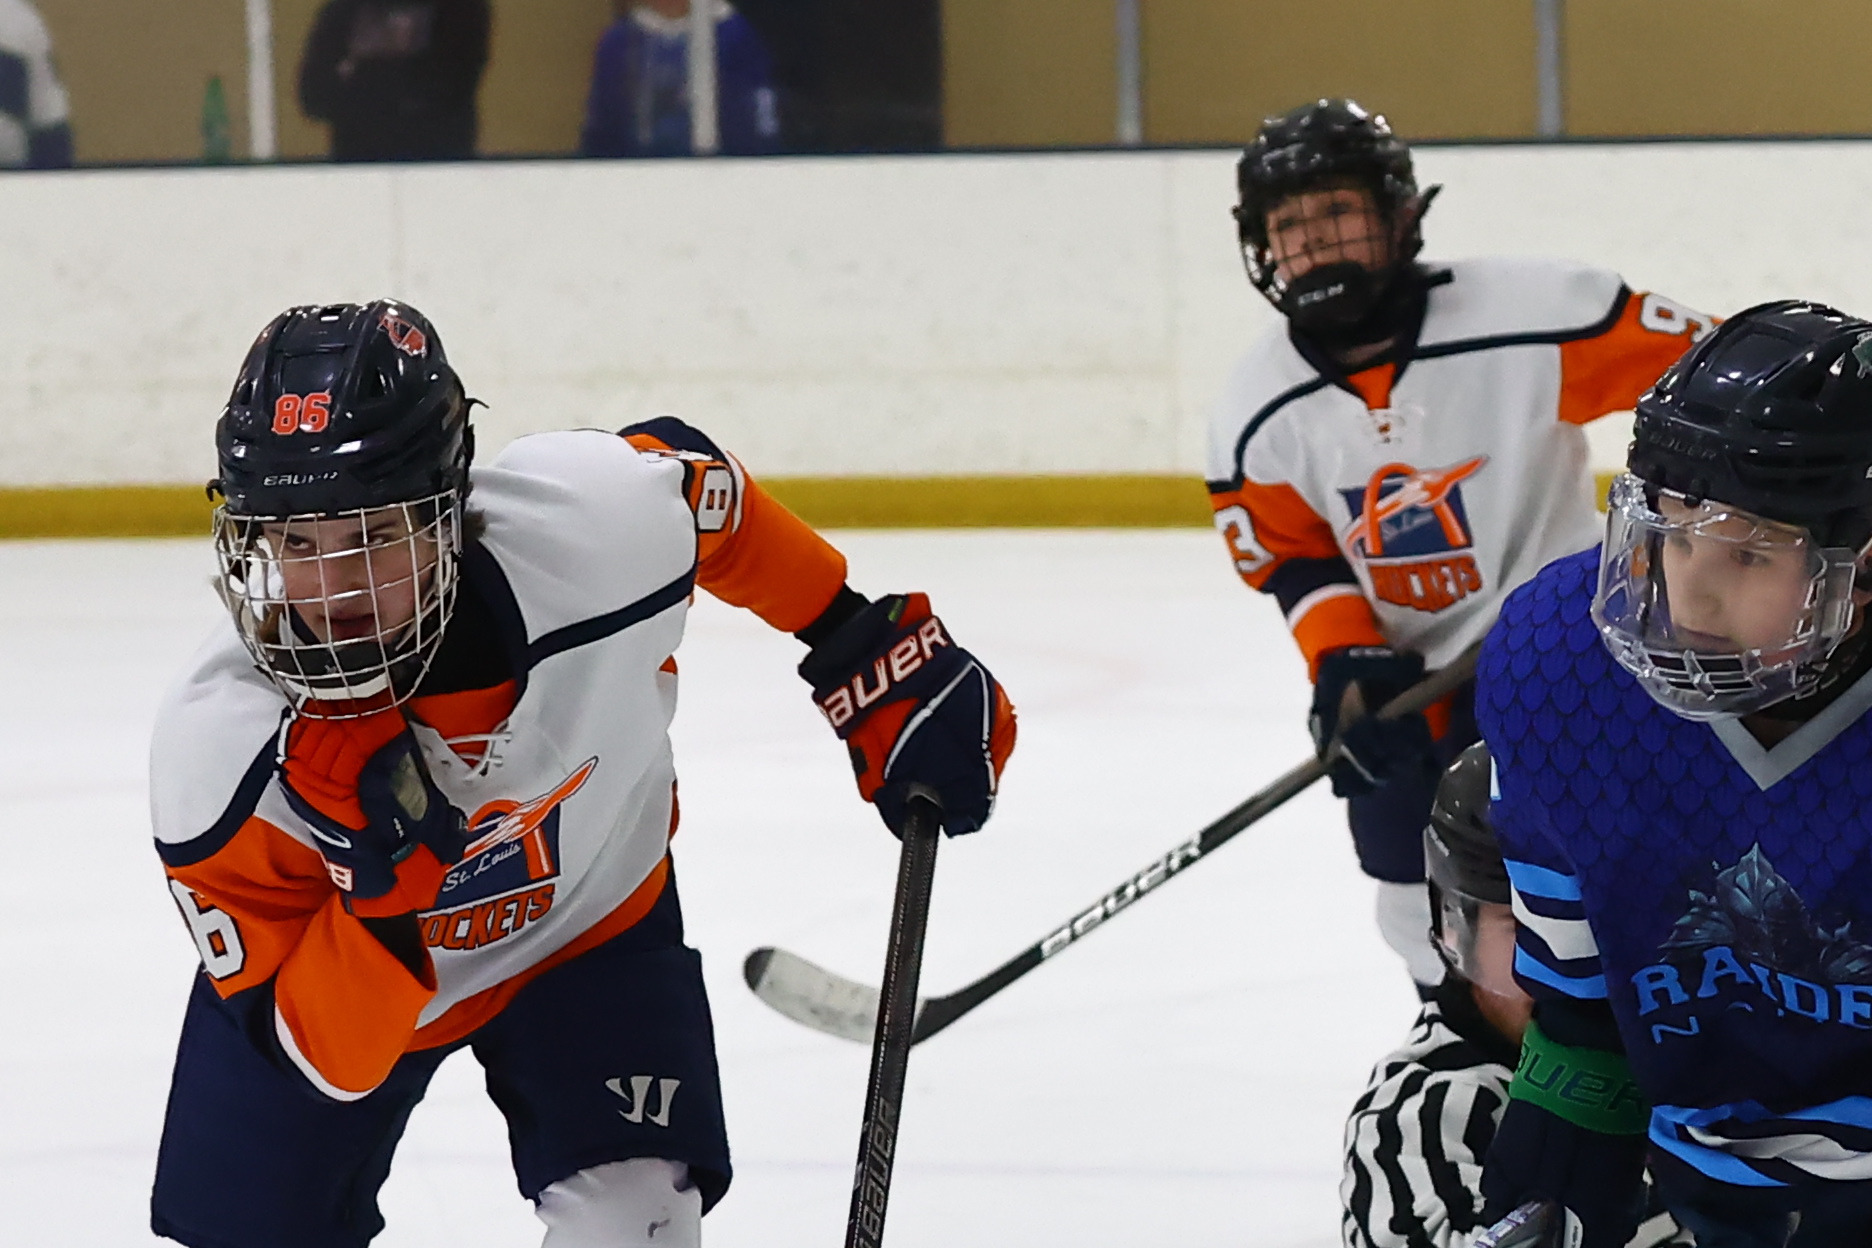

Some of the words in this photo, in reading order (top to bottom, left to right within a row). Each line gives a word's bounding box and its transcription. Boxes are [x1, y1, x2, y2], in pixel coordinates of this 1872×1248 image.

[271, 392, 332, 435] 86
[818, 617, 949, 729] AUER
[473, 842, 521, 876] Louis
[169, 879, 246, 980] 6
[421, 883, 555, 950] OCKETS
[1517, 1043, 1643, 1118] UER
